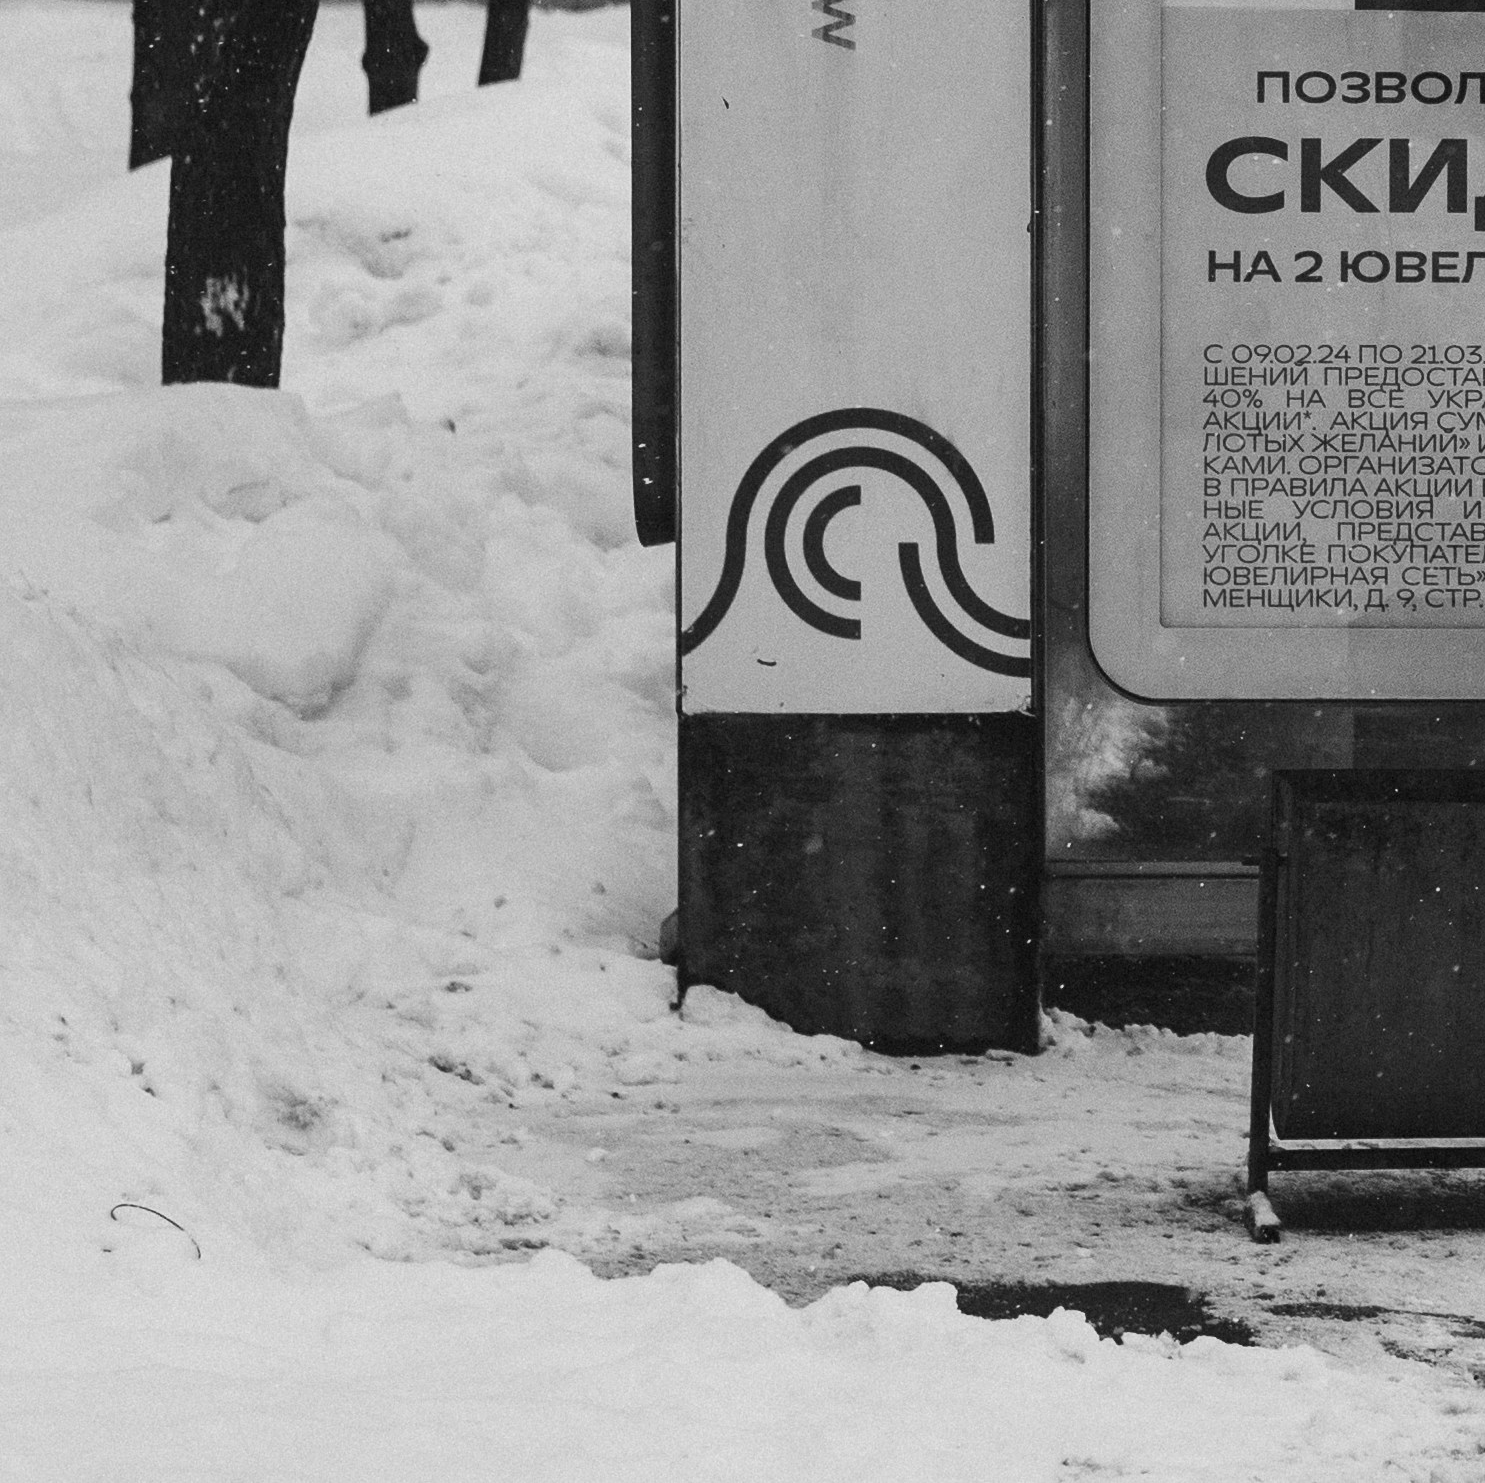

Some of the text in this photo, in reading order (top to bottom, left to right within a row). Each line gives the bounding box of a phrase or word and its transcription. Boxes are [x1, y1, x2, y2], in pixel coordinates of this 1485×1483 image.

[1206, 249, 1282, 284] НА
[1293, 250, 1323, 284] 2
[1203, 344, 1224, 364] С
[1231, 344, 1352, 364] 09.02.24
[1358, 345, 1403, 365] ПО
[1203, 361, 1309, 386] ШЕНИЙ
[1202, 388, 1264, 408] 40%
[1286, 389, 1327, 409] НА
[1347, 389, 1405, 409] ВСЕ
[1329, 411, 1429, 436] АКЦИЯ
[1202, 433, 1305, 453] ЛОТЫХ
[1203, 455, 1291, 475] КАМИ.
[1203, 477, 1222, 497] В
[1230, 477, 1369, 497] ПРАВИЛА
[1373, 478, 1473, 502] АКЦИИ
[1203, 499, 1265, 519] НЫЕ
[1291, 500, 1434, 520] УСЛОВИЯ
[1462, 500, 1482, 520] И
[1202, 521, 1307, 546] АКЦИИ,
[1201, 544, 1316, 564] УГОЛКЕ
[1203, 566, 1389, 586] ЮВЕЛИРНАЯ
[1202, 588, 1359, 612] МЕНЩИКИ,
[1363, 588, 1390, 613] Д.
[1396, 588, 1417, 613] 9,
[1424, 588, 1484, 608] СТР.
